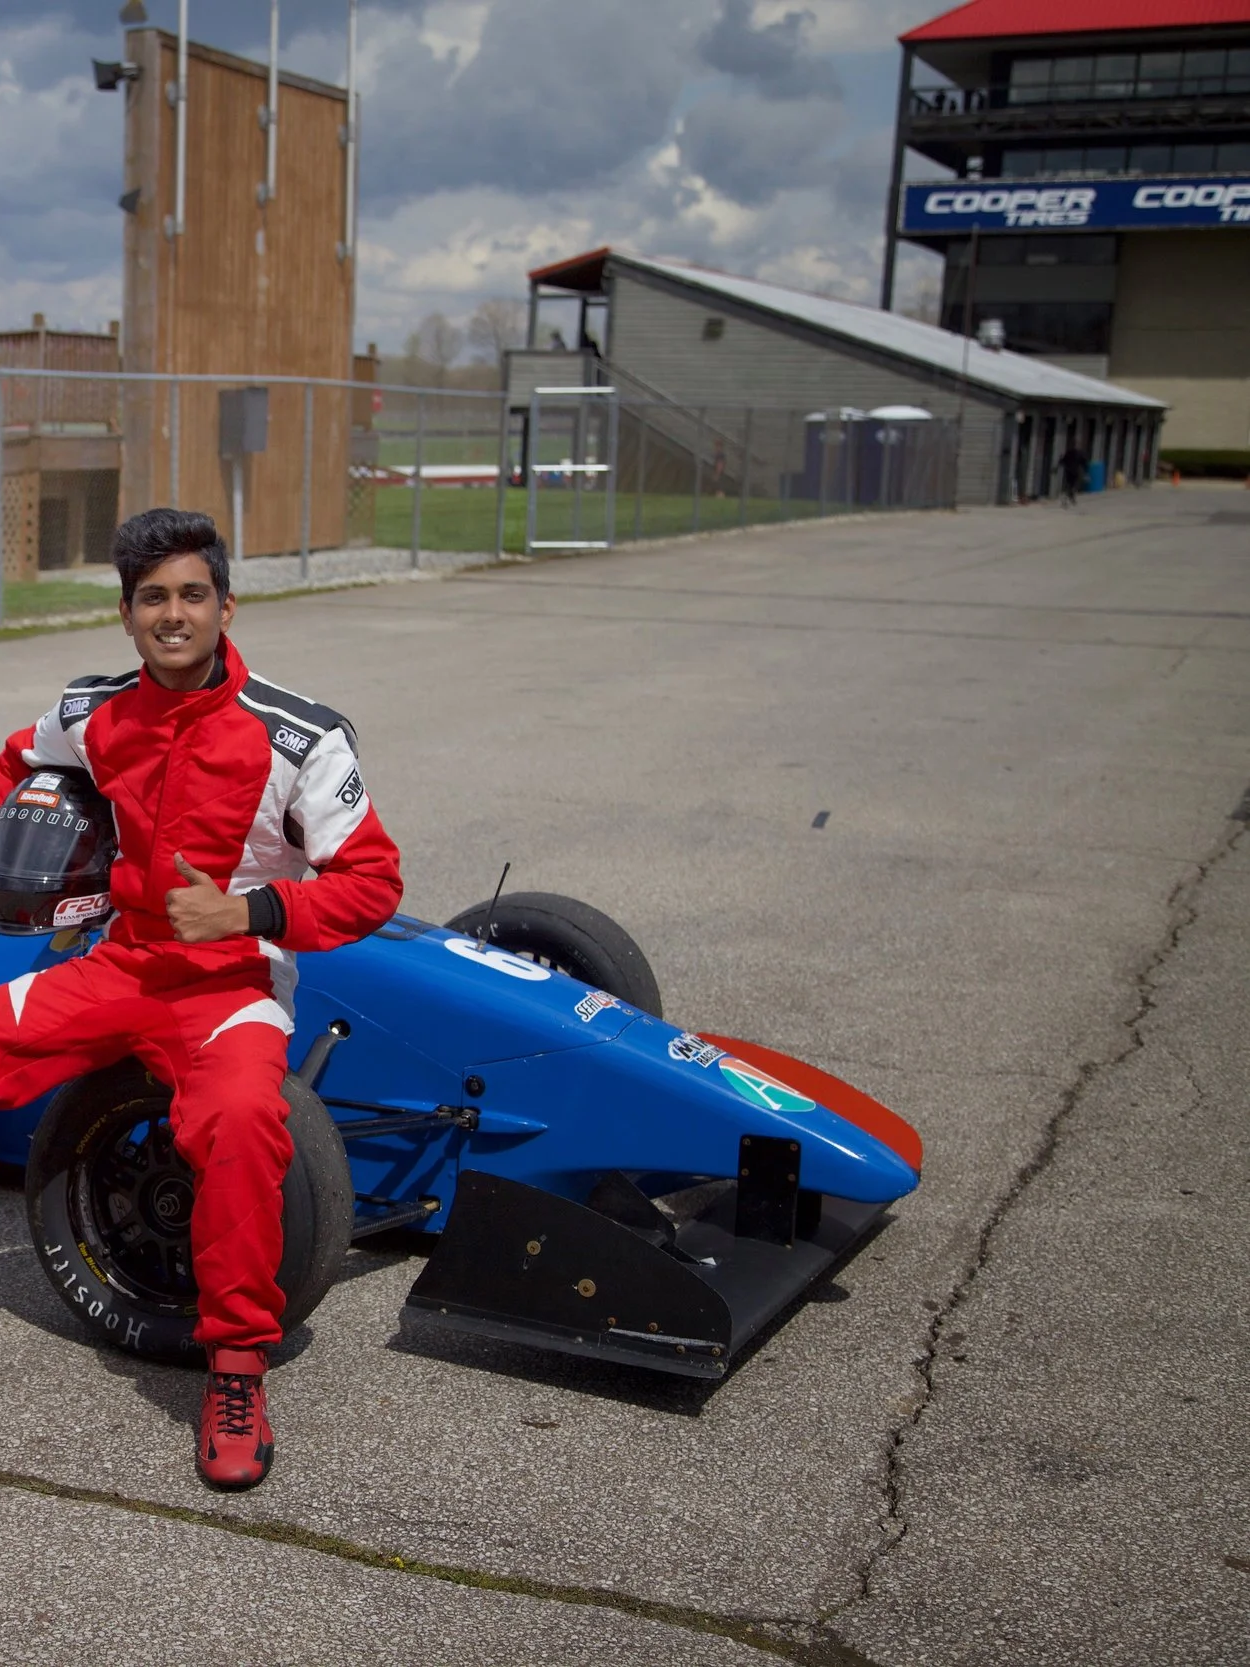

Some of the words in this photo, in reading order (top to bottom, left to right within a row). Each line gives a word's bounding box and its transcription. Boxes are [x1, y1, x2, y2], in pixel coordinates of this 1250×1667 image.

[924, 188, 1096, 214] COOPER
[1005, 211, 1090, 227] TIRES
[63, 700, 90, 715] OMP
[275, 729, 309, 751] OMP
[444, 938, 551, 981] 6
[44, 1245, 151, 1349] Hoosier
